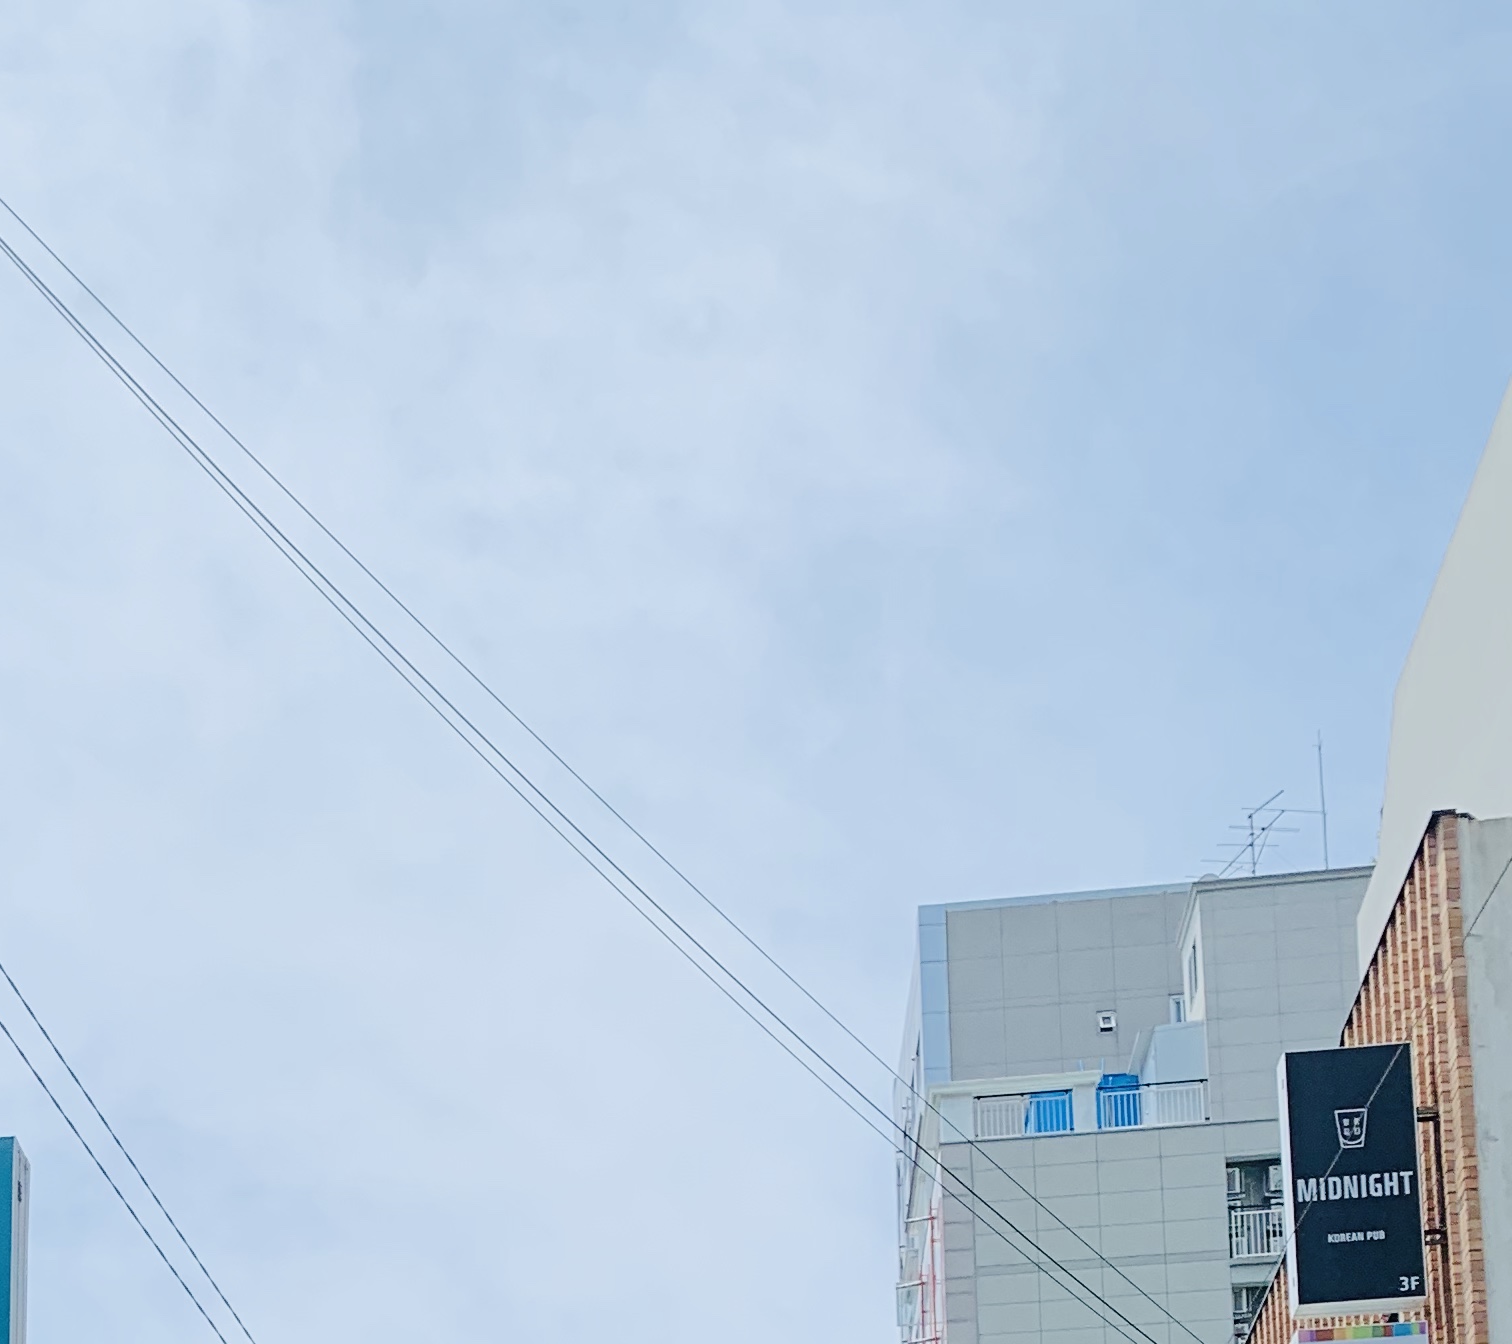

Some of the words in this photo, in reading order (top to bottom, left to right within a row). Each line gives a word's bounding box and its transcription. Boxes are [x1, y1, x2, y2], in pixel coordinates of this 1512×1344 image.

[1296, 1171, 1414, 1203] MIDNIGHT
[1327, 1230, 1365, 1244] KOREAN
[1367, 1230, 1386, 1241] PUB
[1399, 1276, 1420, 1292] 3F
